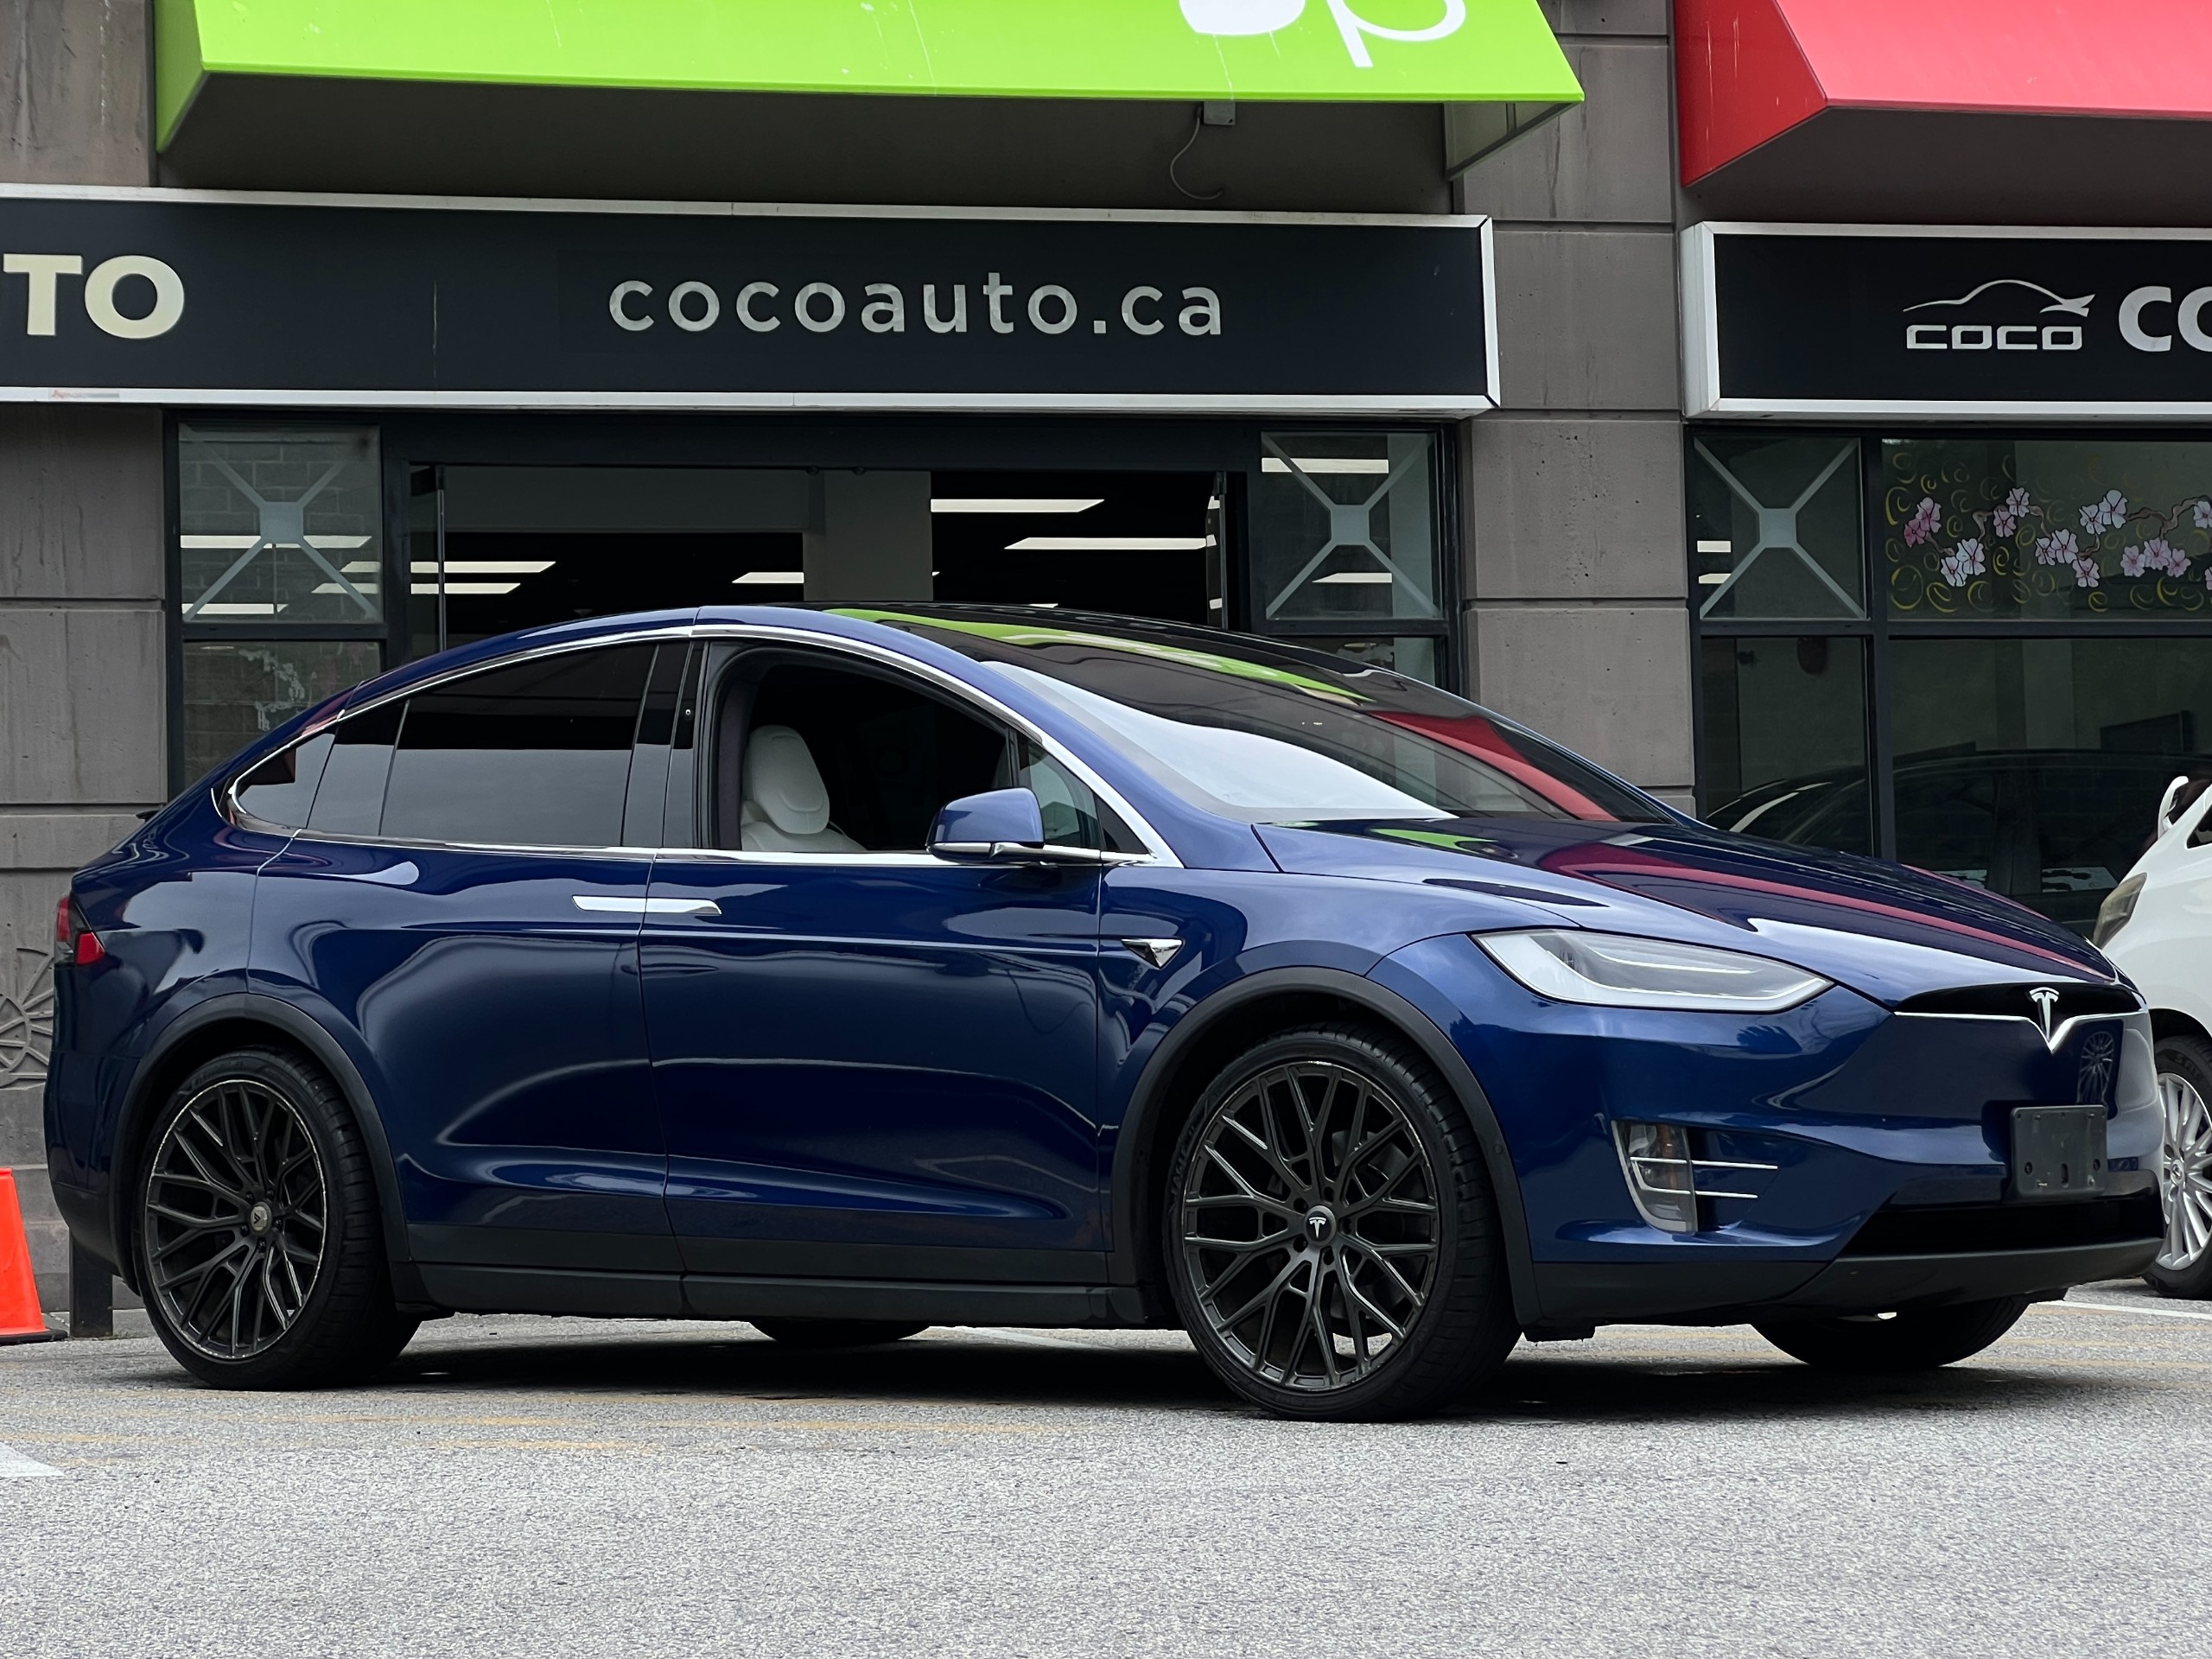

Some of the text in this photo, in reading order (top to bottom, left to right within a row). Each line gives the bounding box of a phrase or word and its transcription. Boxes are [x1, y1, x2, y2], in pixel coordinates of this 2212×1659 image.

[3, 253, 185, 340] TO
[609, 272, 1222, 336] cocoauto.ca
[1906, 324, 2082, 351] COCO
